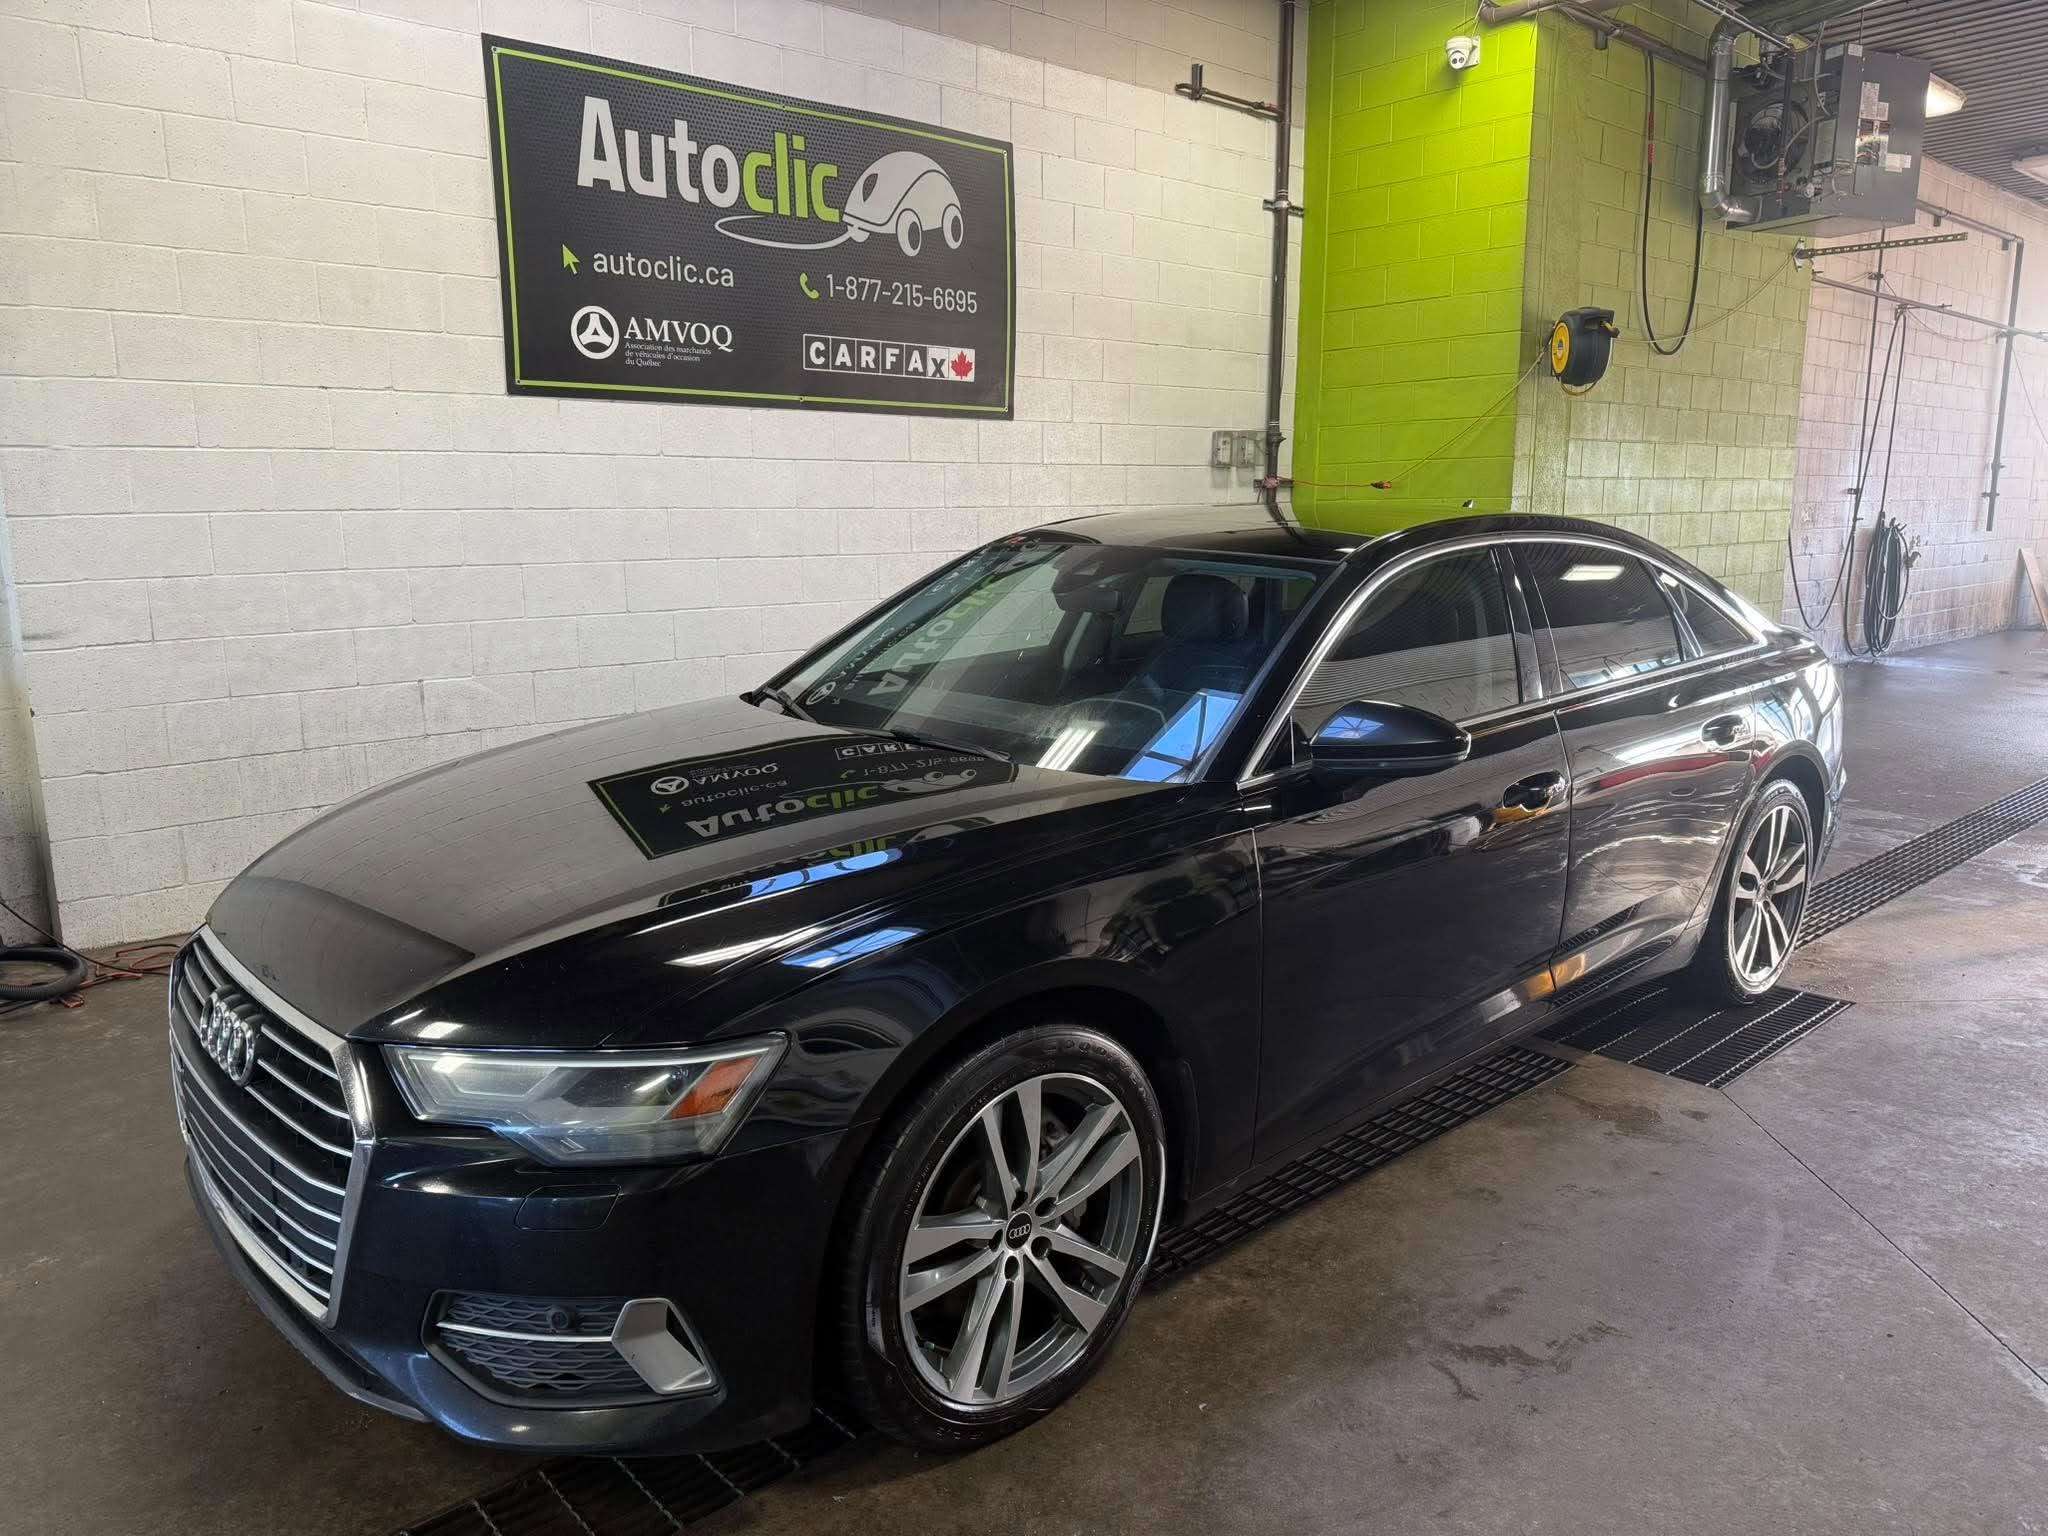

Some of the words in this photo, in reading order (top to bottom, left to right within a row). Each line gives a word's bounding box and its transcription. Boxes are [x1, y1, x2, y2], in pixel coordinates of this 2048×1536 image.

[577, 95, 840, 223] Autoclic
[593, 251, 735, 288] autoclic.ca
[825, 273, 978, 314] 1-877-215-6695
[624, 317, 734, 353] AMVOQ
[809, 341, 947, 378] CARFAX
